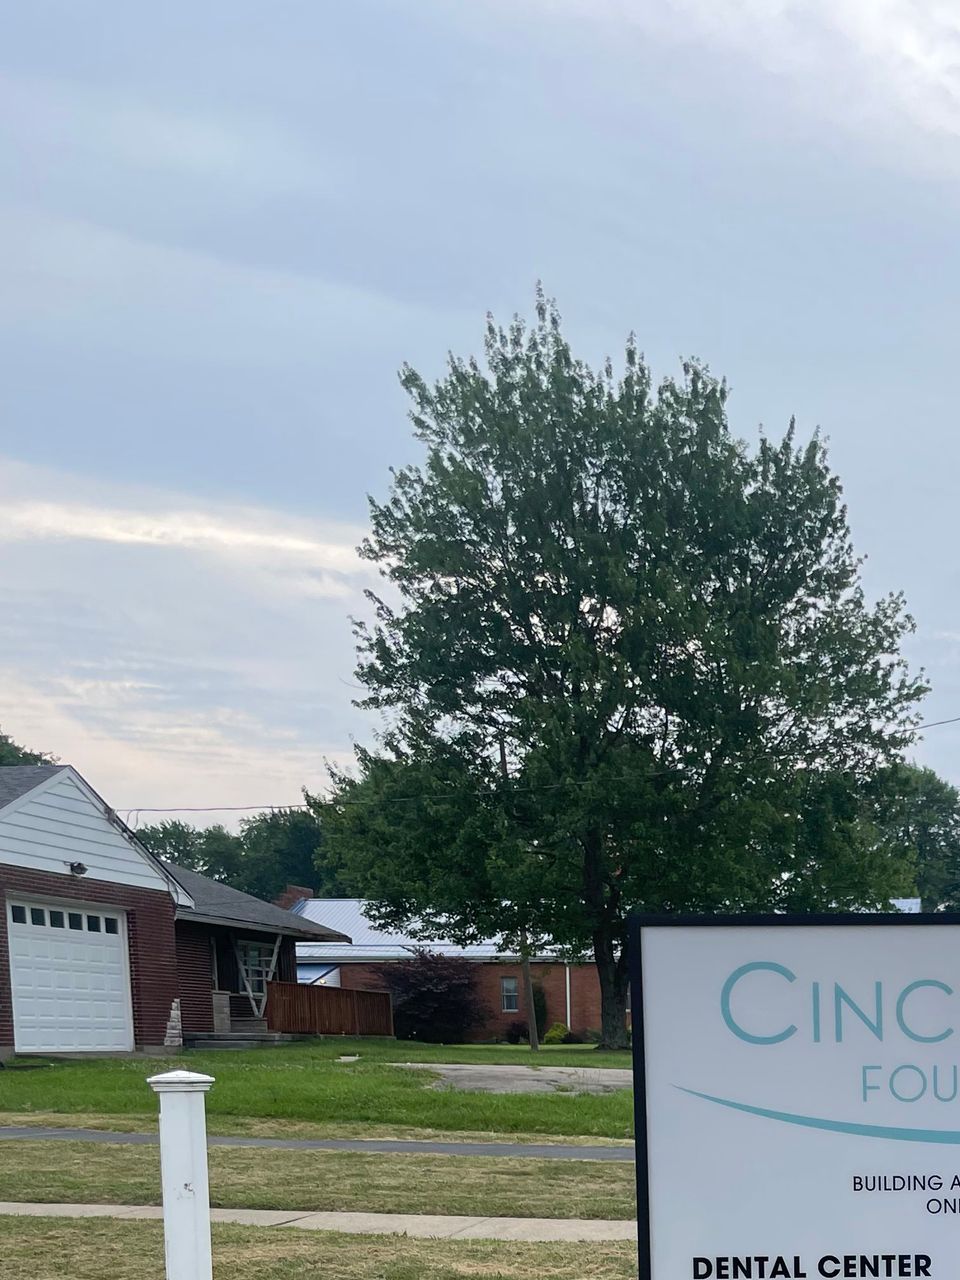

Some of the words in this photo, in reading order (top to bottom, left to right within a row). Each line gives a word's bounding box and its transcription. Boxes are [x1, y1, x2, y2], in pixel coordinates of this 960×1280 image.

[853, 1174, 944, 1193] BUILDING
[693, 1256, 807, 1280] DENTAL
[817, 1253, 933, 1280] CENTER
